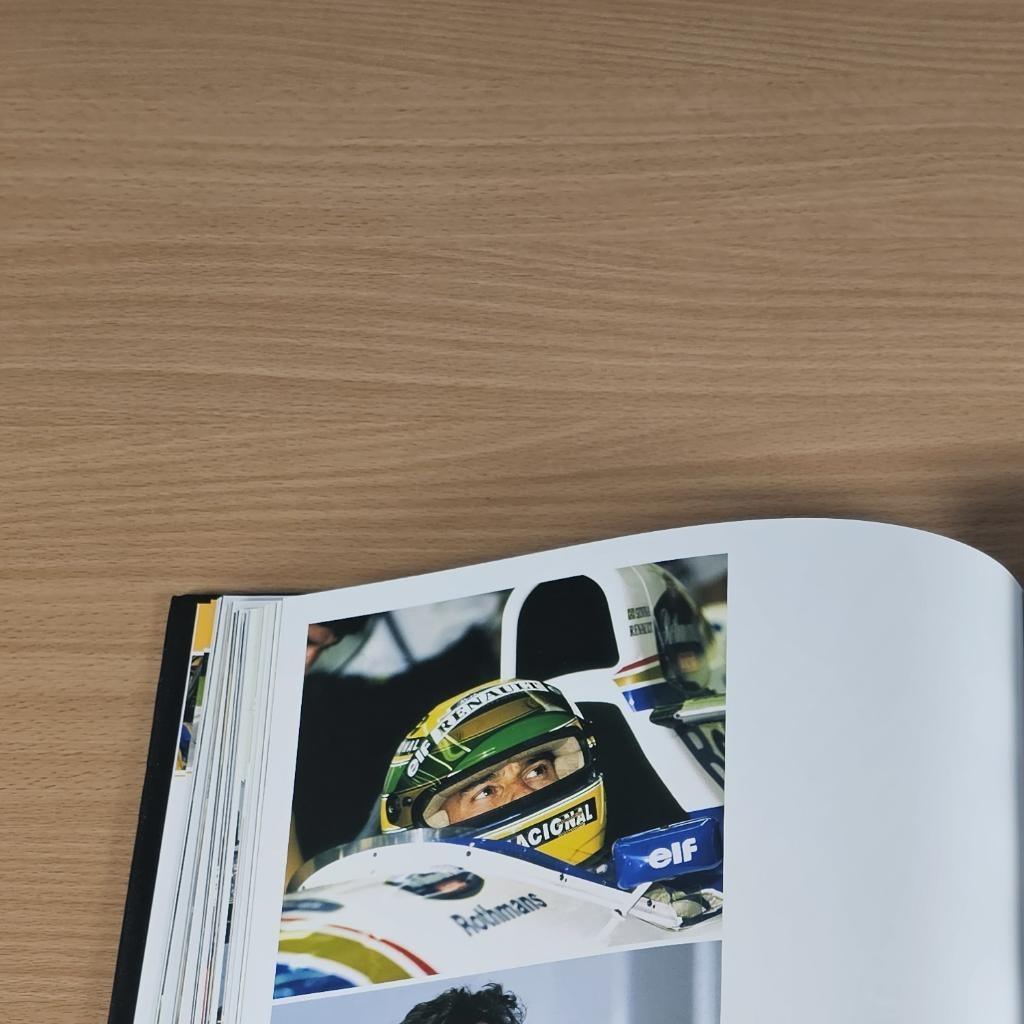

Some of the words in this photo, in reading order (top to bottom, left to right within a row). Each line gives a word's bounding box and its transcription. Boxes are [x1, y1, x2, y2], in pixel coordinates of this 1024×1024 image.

[438, 680, 542, 734] RENAULT
[508, 803, 594, 848] ACIONAL
[648, 837, 698, 870] elf
[450, 893, 548, 937] Rothmans
